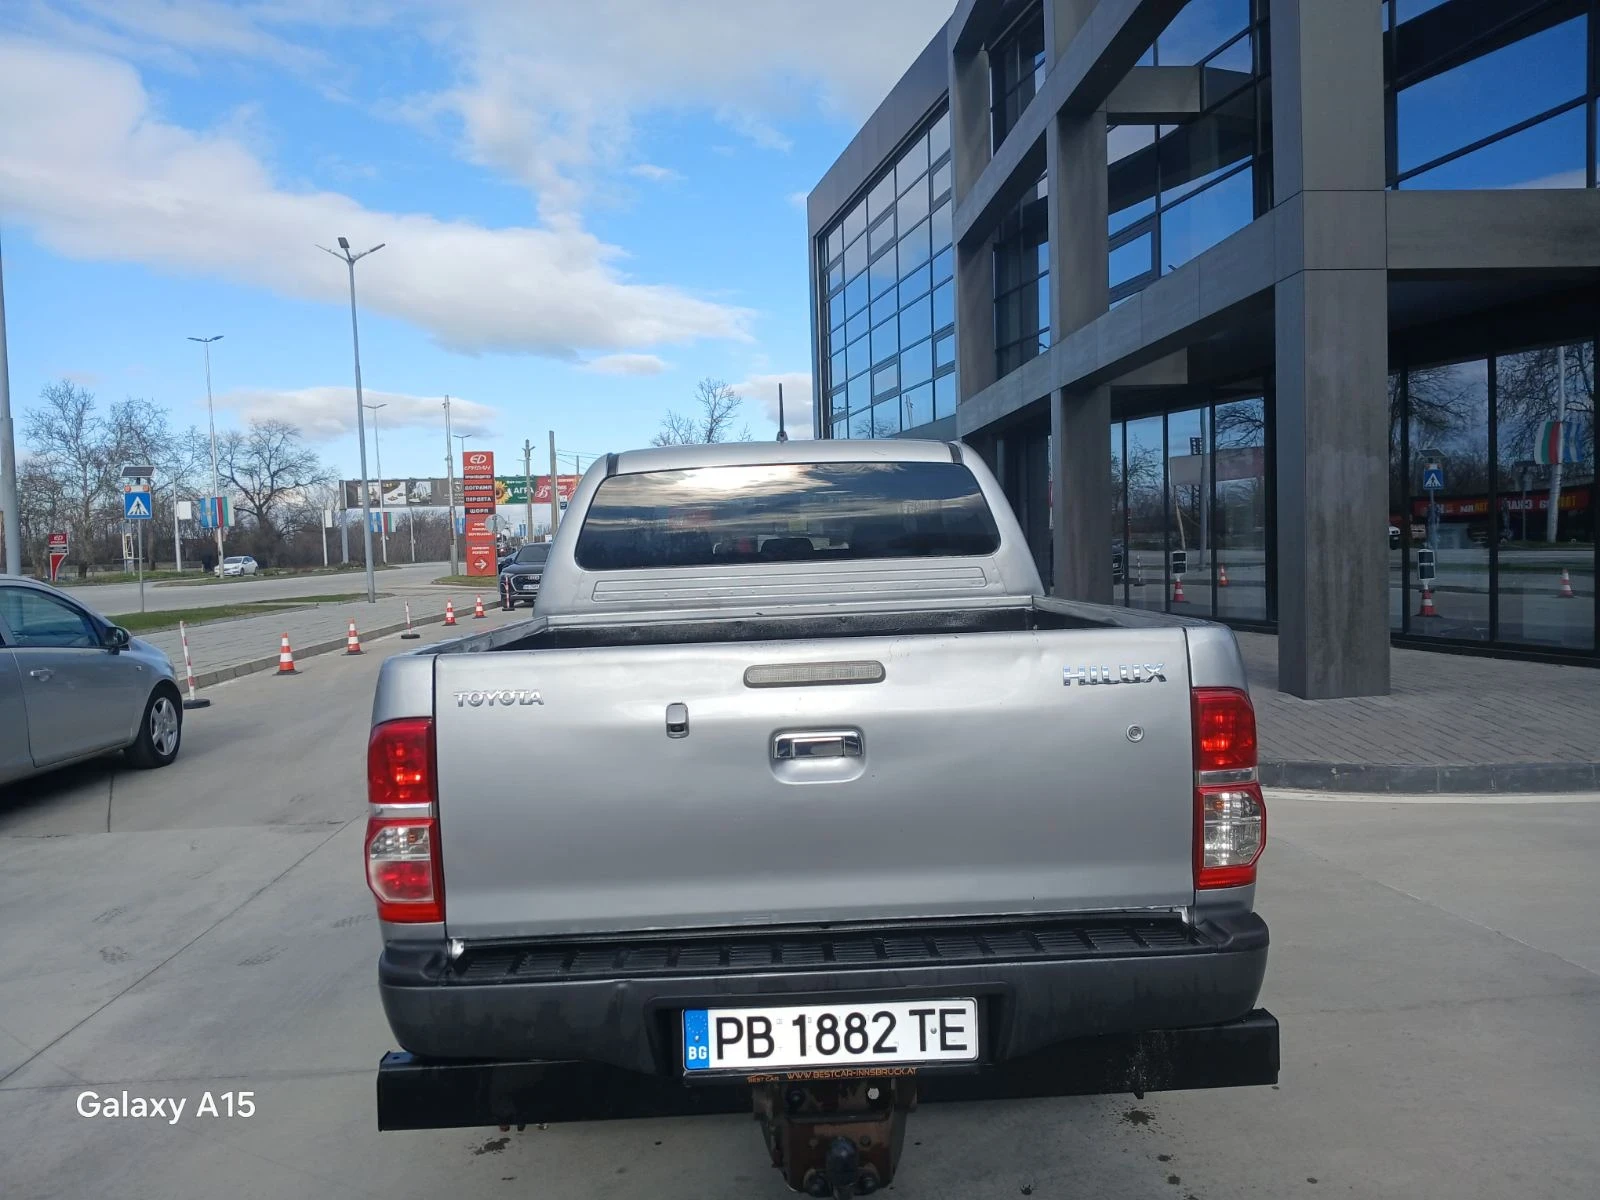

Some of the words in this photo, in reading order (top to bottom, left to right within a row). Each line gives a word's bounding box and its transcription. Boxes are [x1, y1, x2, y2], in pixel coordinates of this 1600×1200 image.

[1063, 663, 1167, 686] HILUX
[453, 689, 544, 707] TOYOTA
[715, 1016, 775, 1060] PB
[792, 1010, 898, 1057] 1882
[908, 1008, 968, 1052] TE
[688, 1046, 707, 1060] BG
